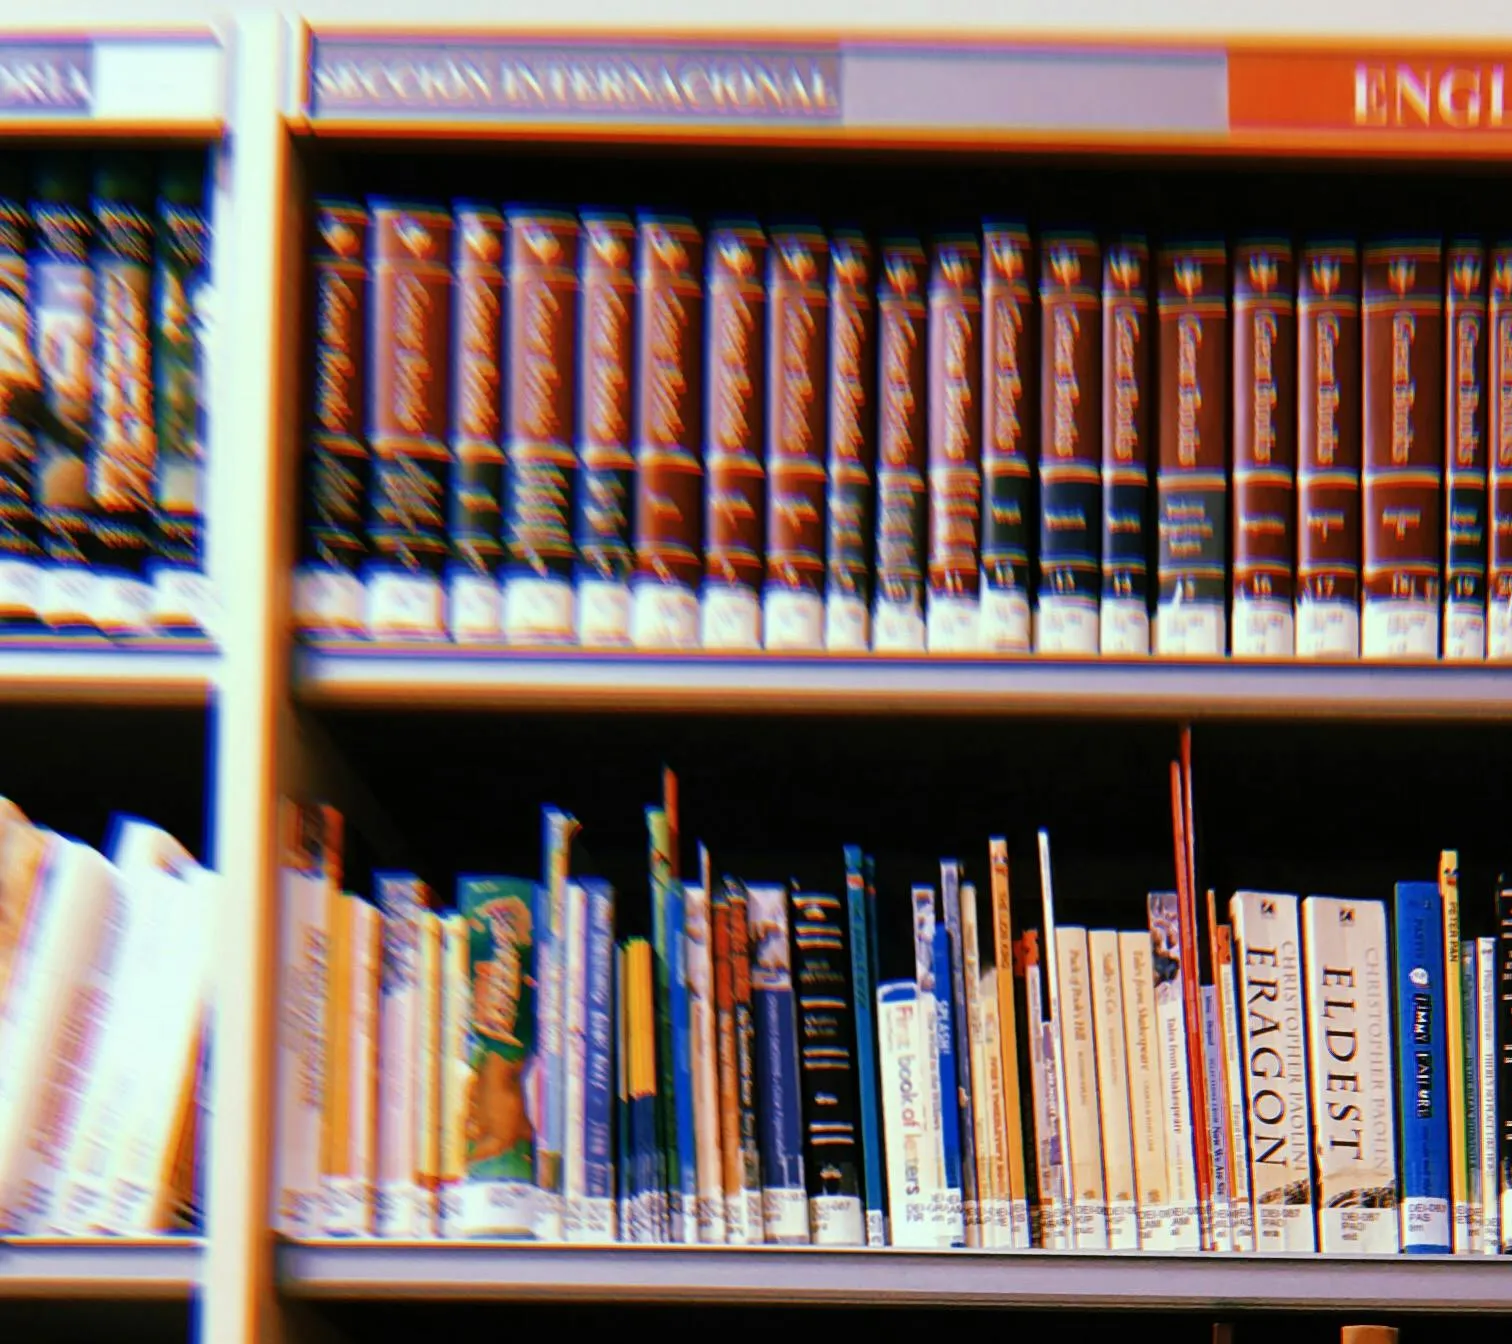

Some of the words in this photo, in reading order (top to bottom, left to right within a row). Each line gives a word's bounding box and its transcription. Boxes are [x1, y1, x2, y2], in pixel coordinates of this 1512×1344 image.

[1132, 951, 1145, 976] Tales
[937, 1000, 950, 1054] SPLASH!
[1074, 1021, 1086, 1040] Hill
[1137, 1008, 1150, 1071] Shakespeare
[1166, 1017, 1177, 1042] Tales
[1280, 941, 1303, 1084] CHRISTOPHER
[898, 1056, 917, 1104] book
[1167, 1045, 1179, 1068] from
[1245, 946, 1287, 1168] ERAGON
[1321, 965, 1364, 1162] ELDEST
[901, 1109, 919, 1127] of
[1170, 1072, 1183, 1134] Shakespeare
[1289, 1091, 1307, 1171] PAOLINI
